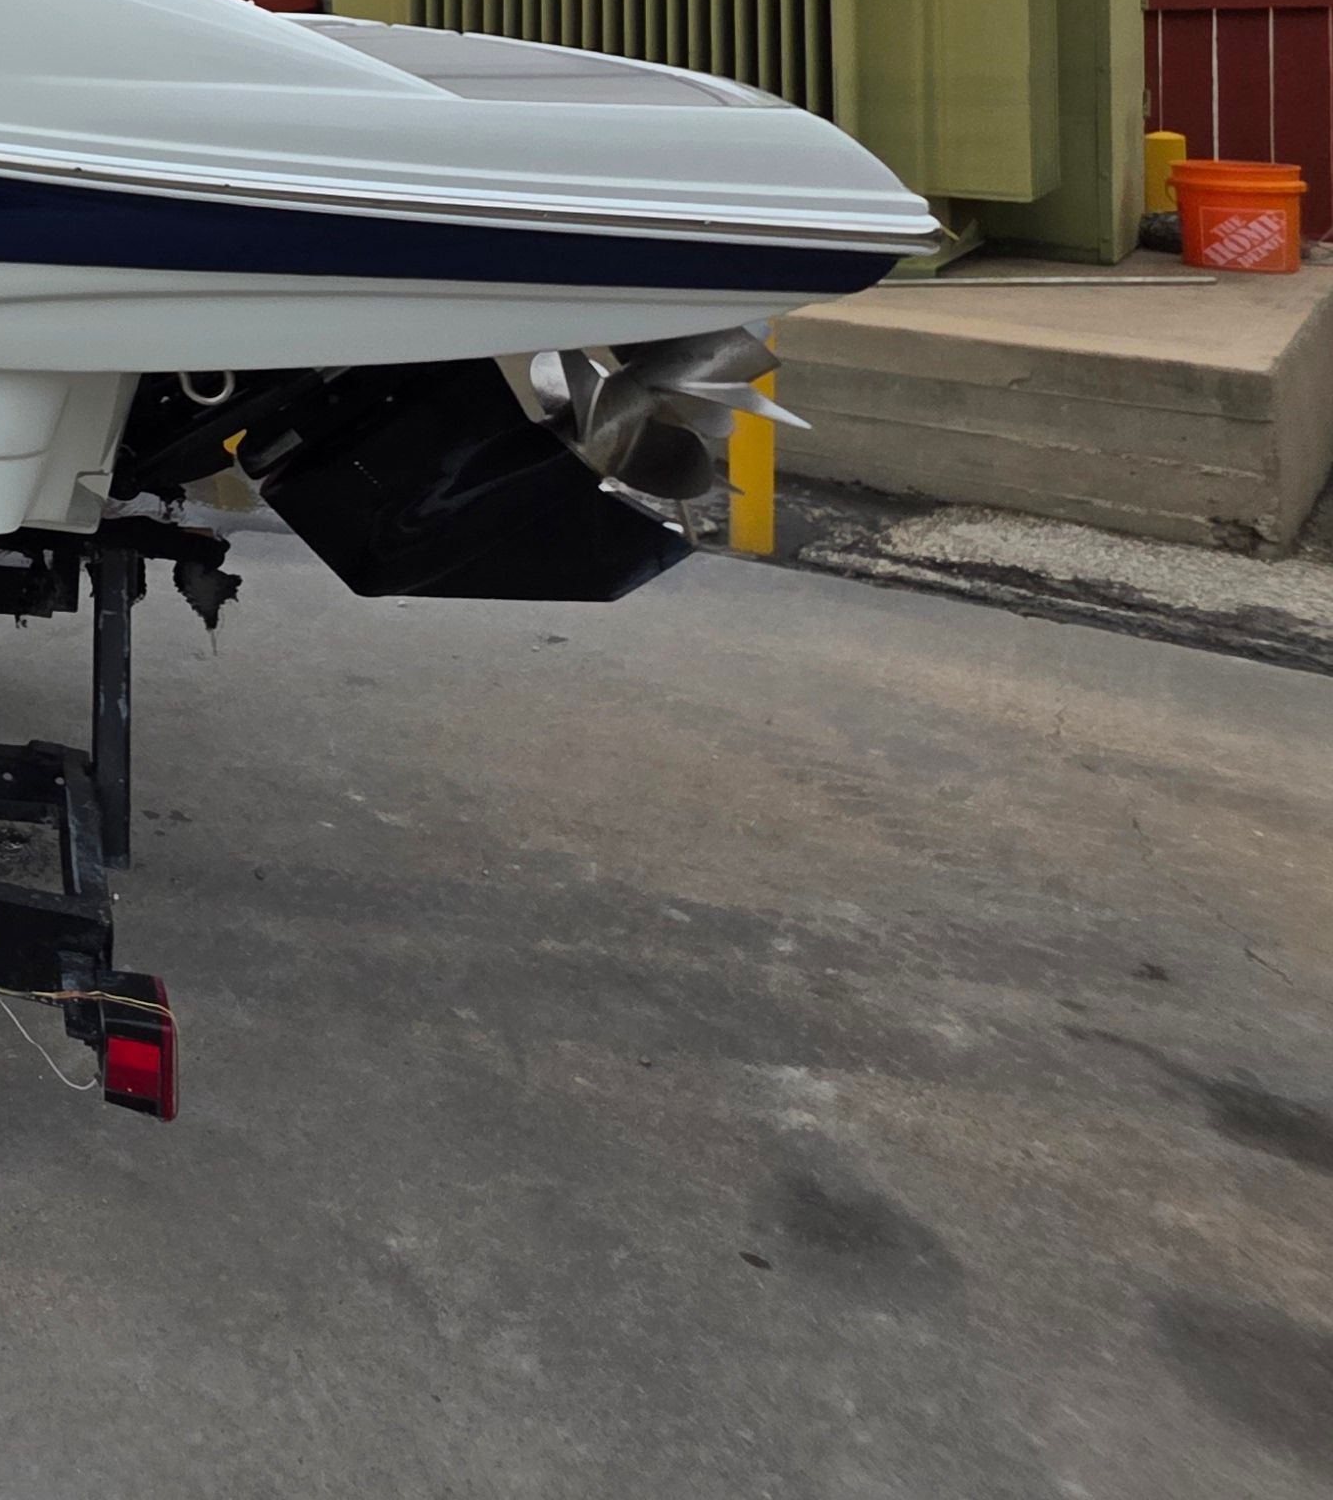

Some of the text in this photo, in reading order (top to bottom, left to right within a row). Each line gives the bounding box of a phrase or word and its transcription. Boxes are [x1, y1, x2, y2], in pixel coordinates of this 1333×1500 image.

[1203, 210, 1287, 266] HOME
[1208, 215, 1247, 238] THE
[1236, 233, 1286, 269] DEPOT
